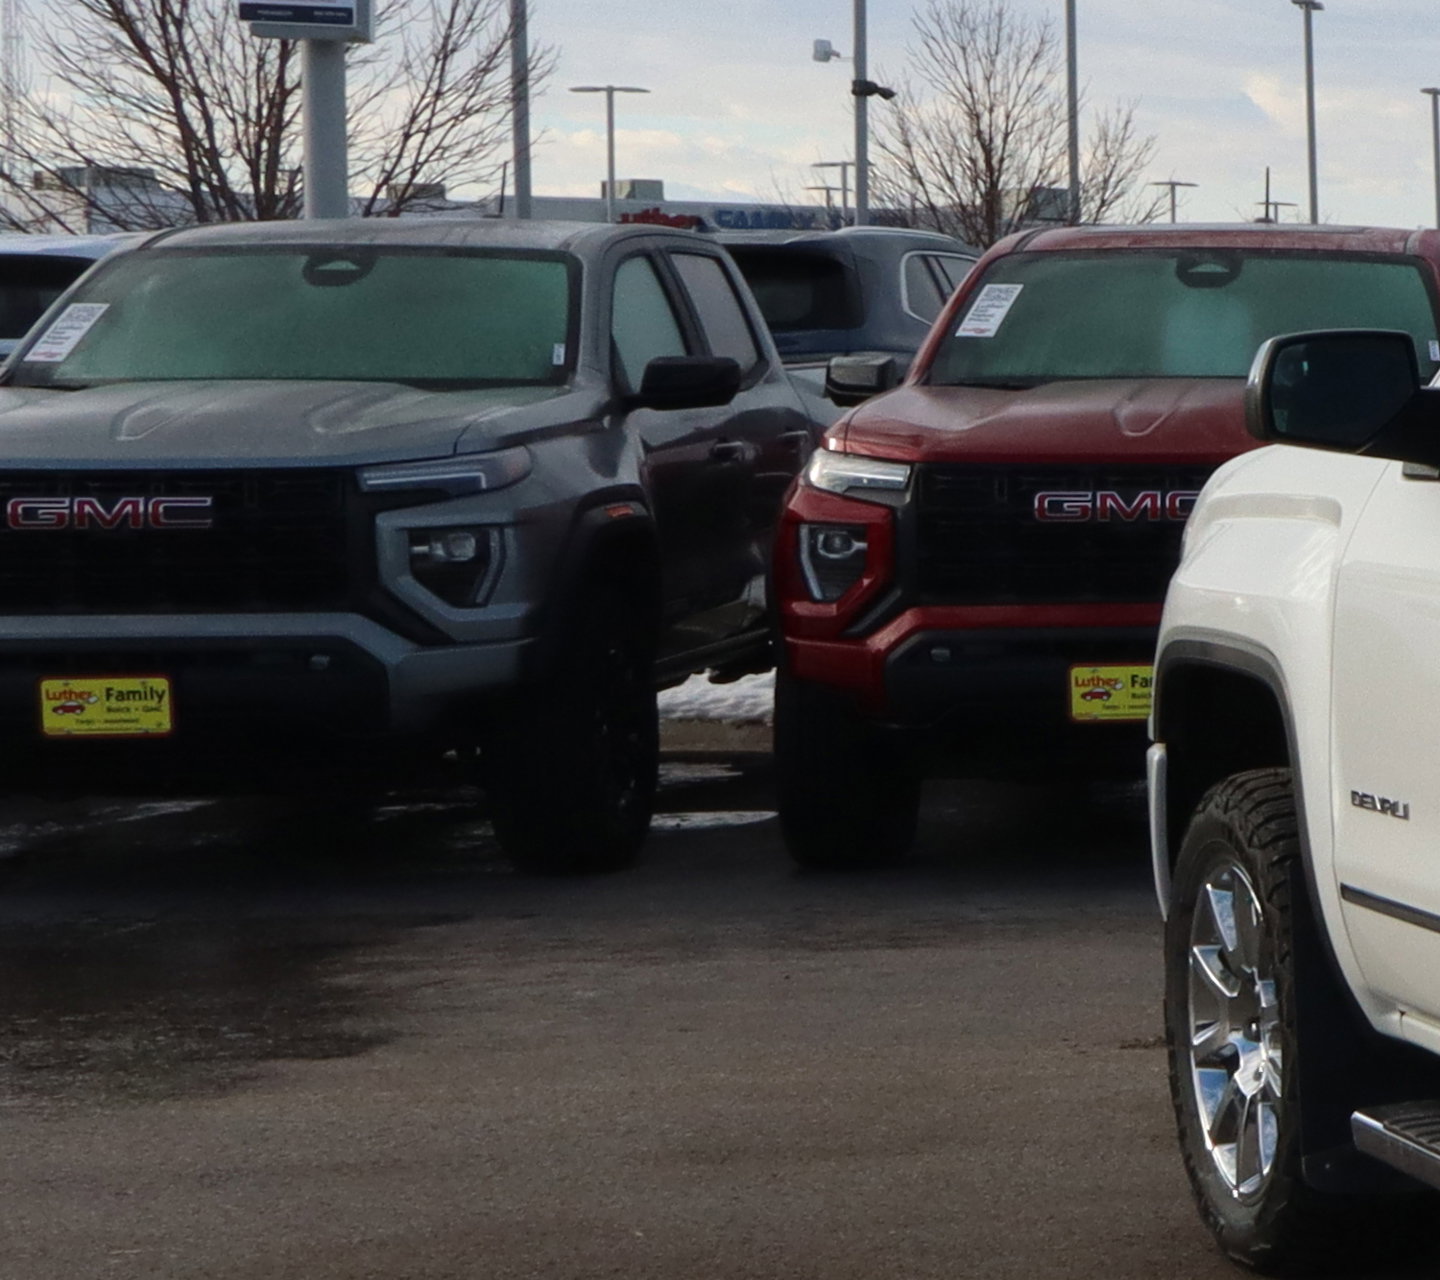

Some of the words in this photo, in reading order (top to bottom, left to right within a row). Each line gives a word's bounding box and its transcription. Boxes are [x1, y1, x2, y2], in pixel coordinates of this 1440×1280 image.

[7, 496, 213, 530] GMC
[105, 685, 166, 704] Family
[1350, 789, 1409, 821] DENALI
